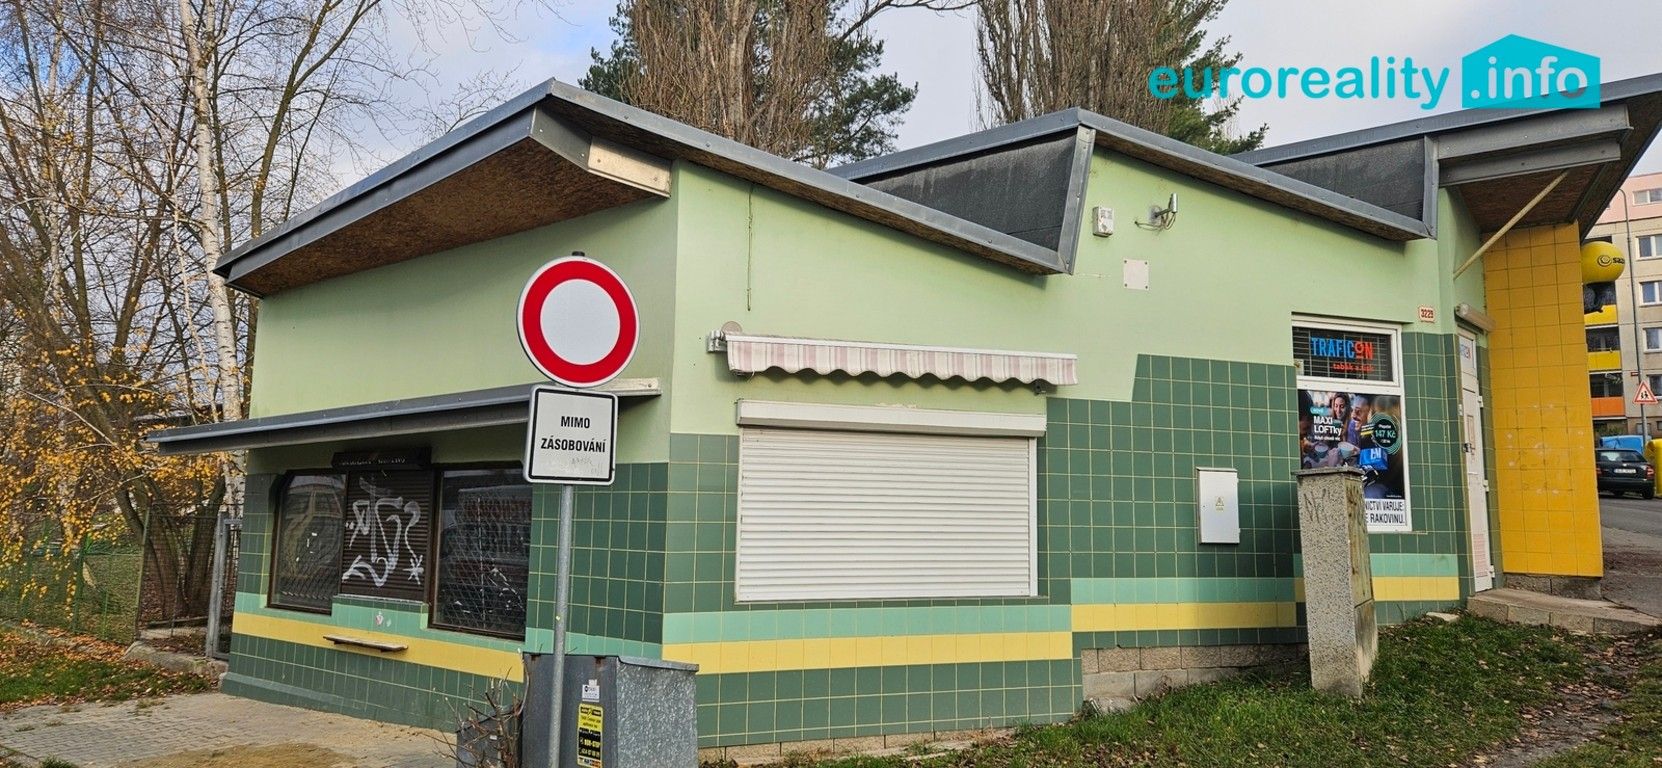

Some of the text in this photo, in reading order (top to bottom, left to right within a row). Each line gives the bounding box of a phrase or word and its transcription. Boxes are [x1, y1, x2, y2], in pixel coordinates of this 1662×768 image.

[1311, 337, 1373, 360] TRAFICON
[560, 415, 590, 428] MIMO
[1313, 415, 1333, 425] MAXI
[1313, 424, 1342, 437] LOFTky
[1375, 429, 1385, 438] 147
[540, 436, 605, 452] ZÁSOBOVÁNÍ
[1370, 513, 1405, 523] RAKOVINU.
